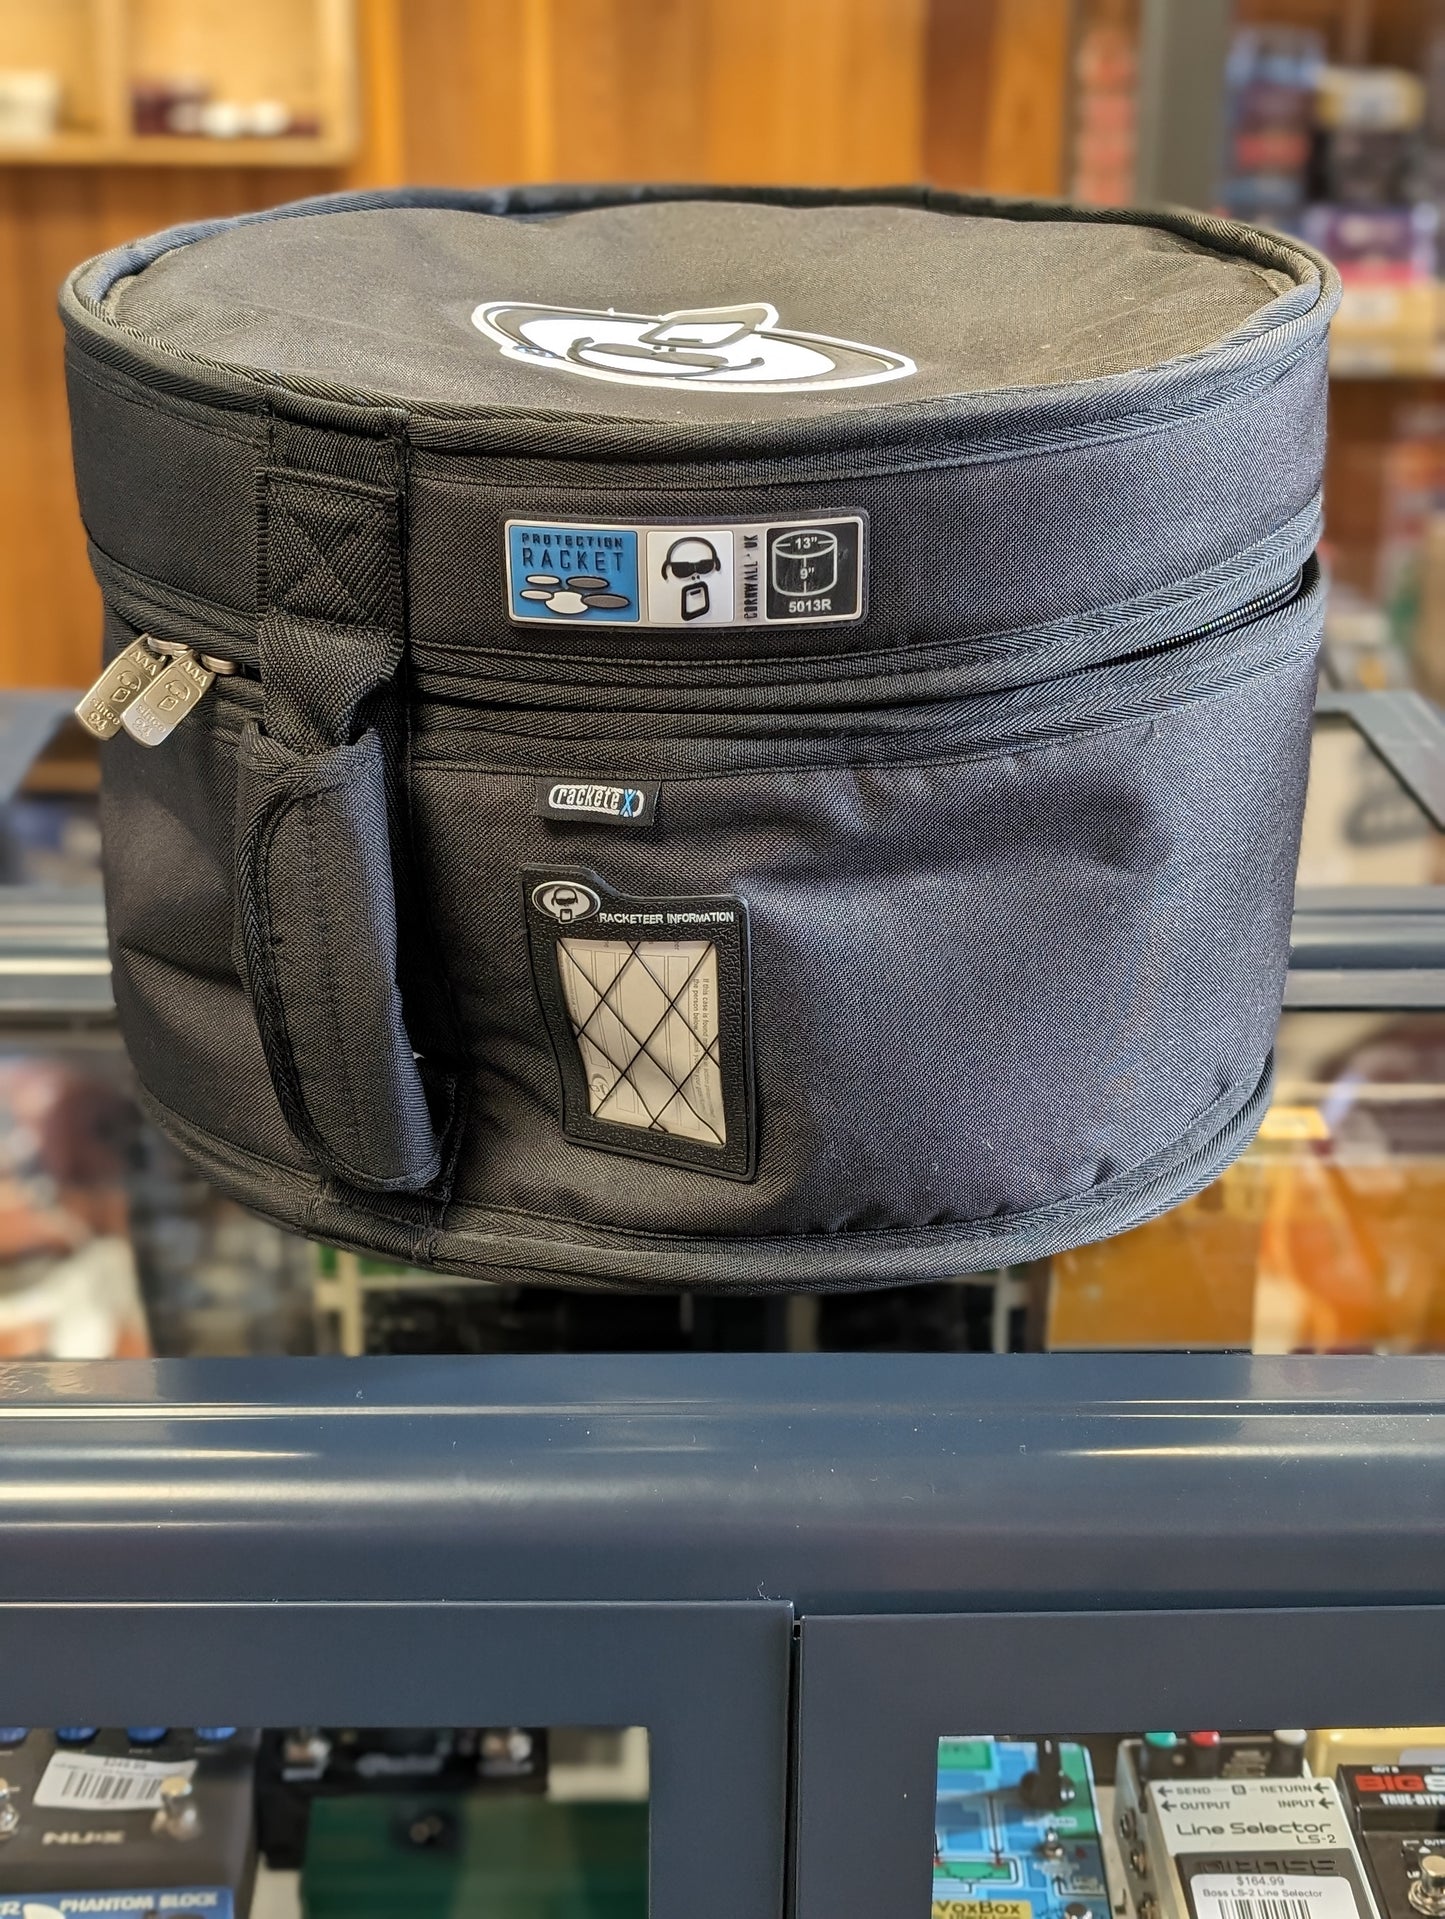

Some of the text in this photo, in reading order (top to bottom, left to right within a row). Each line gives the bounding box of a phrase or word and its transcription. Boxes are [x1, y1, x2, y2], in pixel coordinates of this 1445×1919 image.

[522, 533, 623, 547] PROTECTION
[795, 537, 817, 550] 13"
[522, 548, 623, 572] RACKET
[744, 535, 758, 619] CORNWALL UK
[788, 599, 832, 613] 5013R
[599, 912, 734, 924] RACKETEER INFORMATION
[1175, 1786, 1211, 1795] SEND
[1260, 1784, 1312, 1794] RETURN
[1180, 1801, 1231, 1810] OUTPUT
[1278, 1800, 1315, 1809] INPUT
[1176, 1821, 1331, 1836] Line Selector
[1296, 1834, 1337, 1845] LS-2
[1236, 1876, 1285, 1886] $164.99
[1203, 1889, 1323, 1898] Boss LS-2 Line Selector
[60, 1893, 218, 1913] PHANTOM BLOCK
[936, 1900, 1020, 1915] VoxBox
